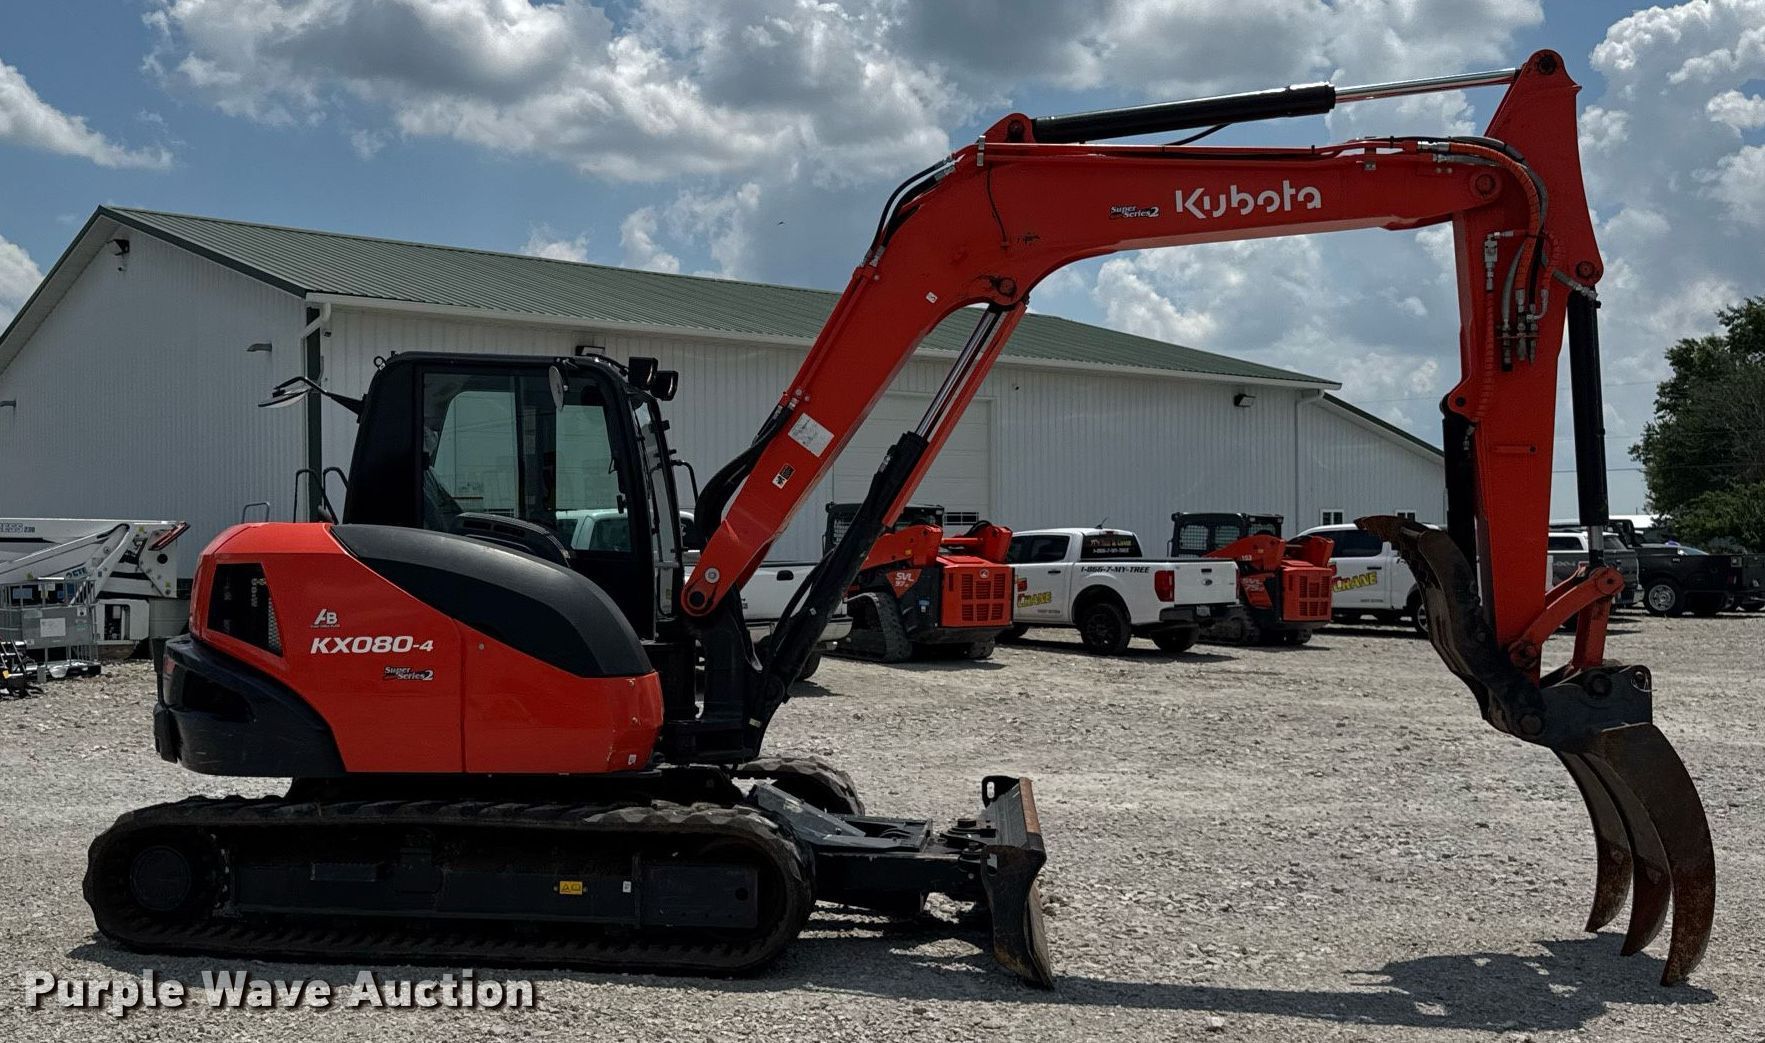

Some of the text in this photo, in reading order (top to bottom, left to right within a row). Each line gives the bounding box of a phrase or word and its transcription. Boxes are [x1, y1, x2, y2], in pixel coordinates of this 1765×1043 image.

[1175, 179, 1321, 219] Kubota
[1111, 206, 1136, 214] Super
[895, 572, 914, 581] SVL
[310, 635, 434, 654] KX080-4
[384, 666, 411, 675] Super
